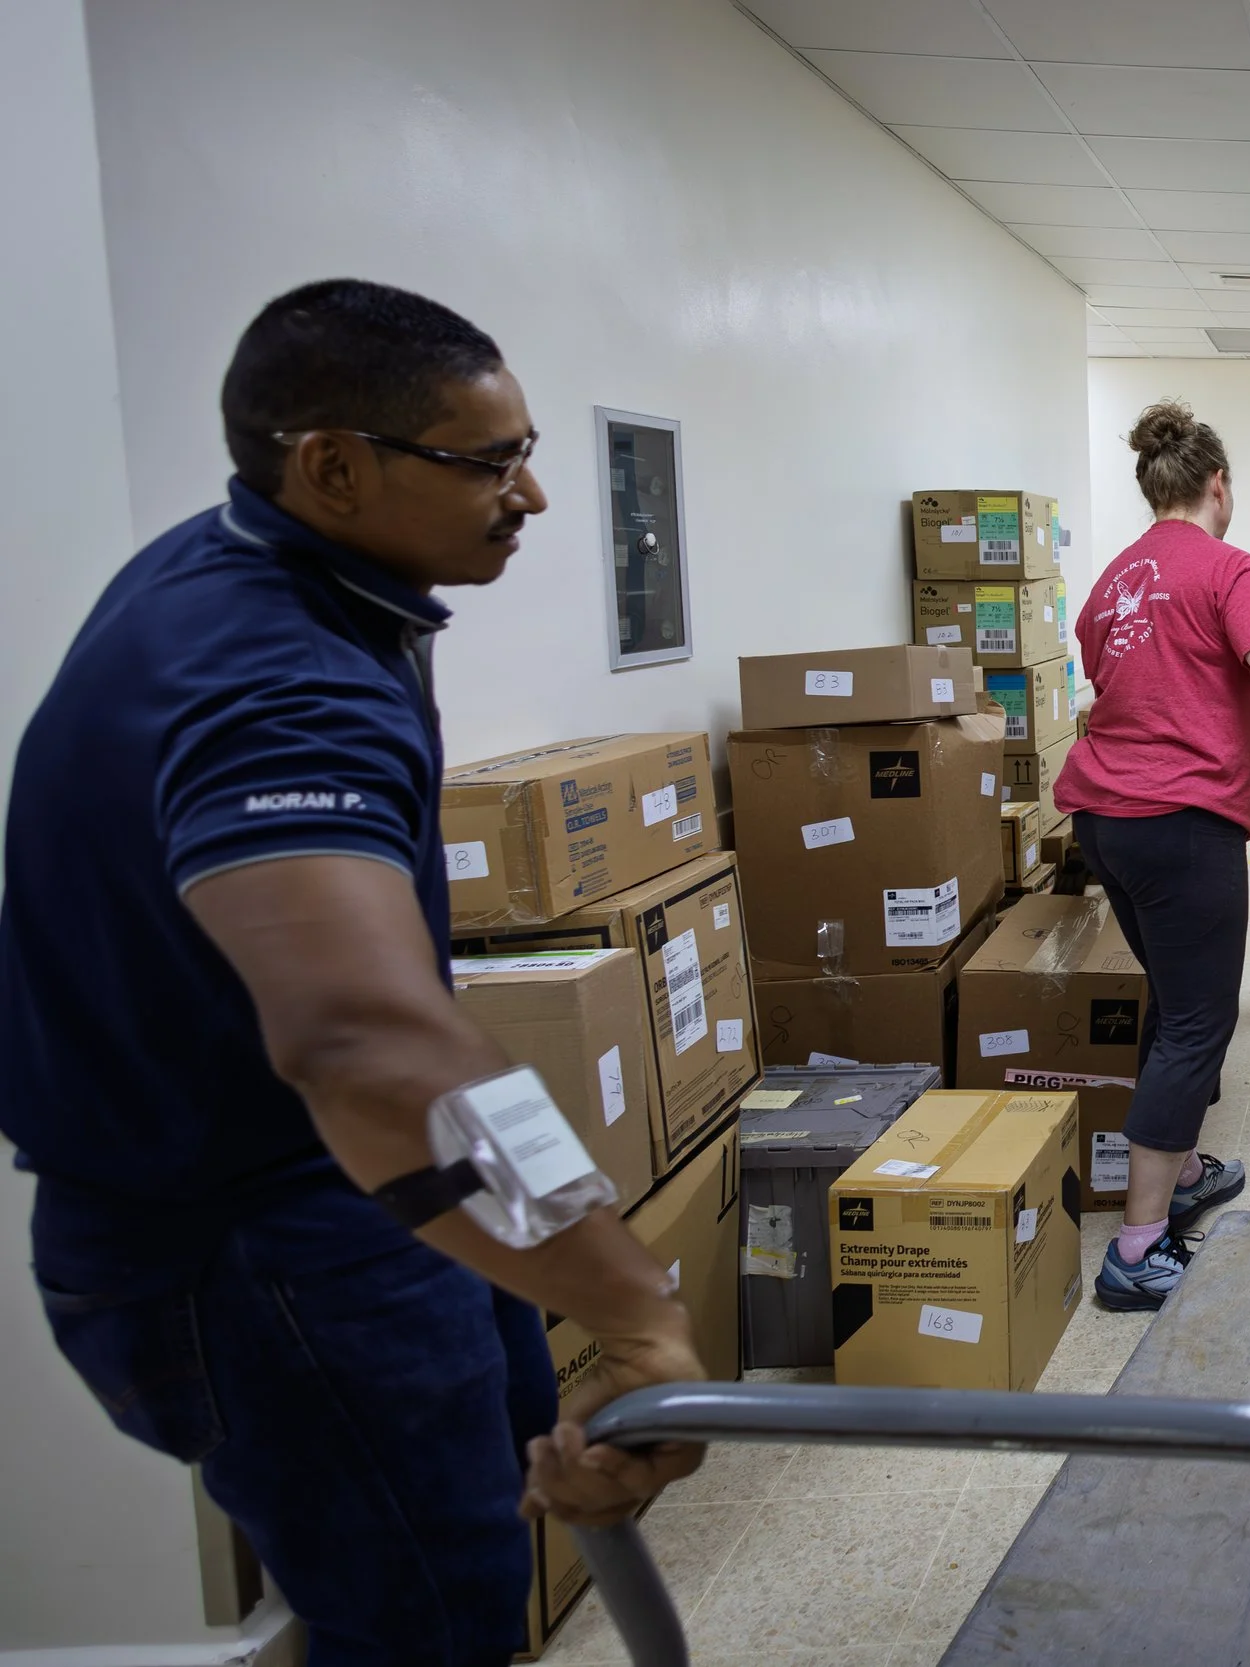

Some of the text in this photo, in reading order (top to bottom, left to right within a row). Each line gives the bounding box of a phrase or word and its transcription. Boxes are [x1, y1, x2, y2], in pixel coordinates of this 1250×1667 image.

[1129, 560, 1140, 570] DC
[920, 606, 951, 617] Biogel
[813, 673, 840, 690] 83
[875, 768, 915, 779] MEDLINE
[246, 791, 367, 812] MORAN P.
[811, 825, 838, 841] 307
[1095, 1017, 1134, 1026] MEDLINE
[986, 1034, 1013, 1050] 308
[840, 1243, 930, 1257] Extremity Drape
[840, 1256, 968, 1269] Champ pour extrémités
[840, 1269, 866, 1277] Sábana
[920, 1271, 961, 1279] extremidad
[927, 1312, 955, 1332] 168
[557, 1340, 600, 1386] RAGIL
